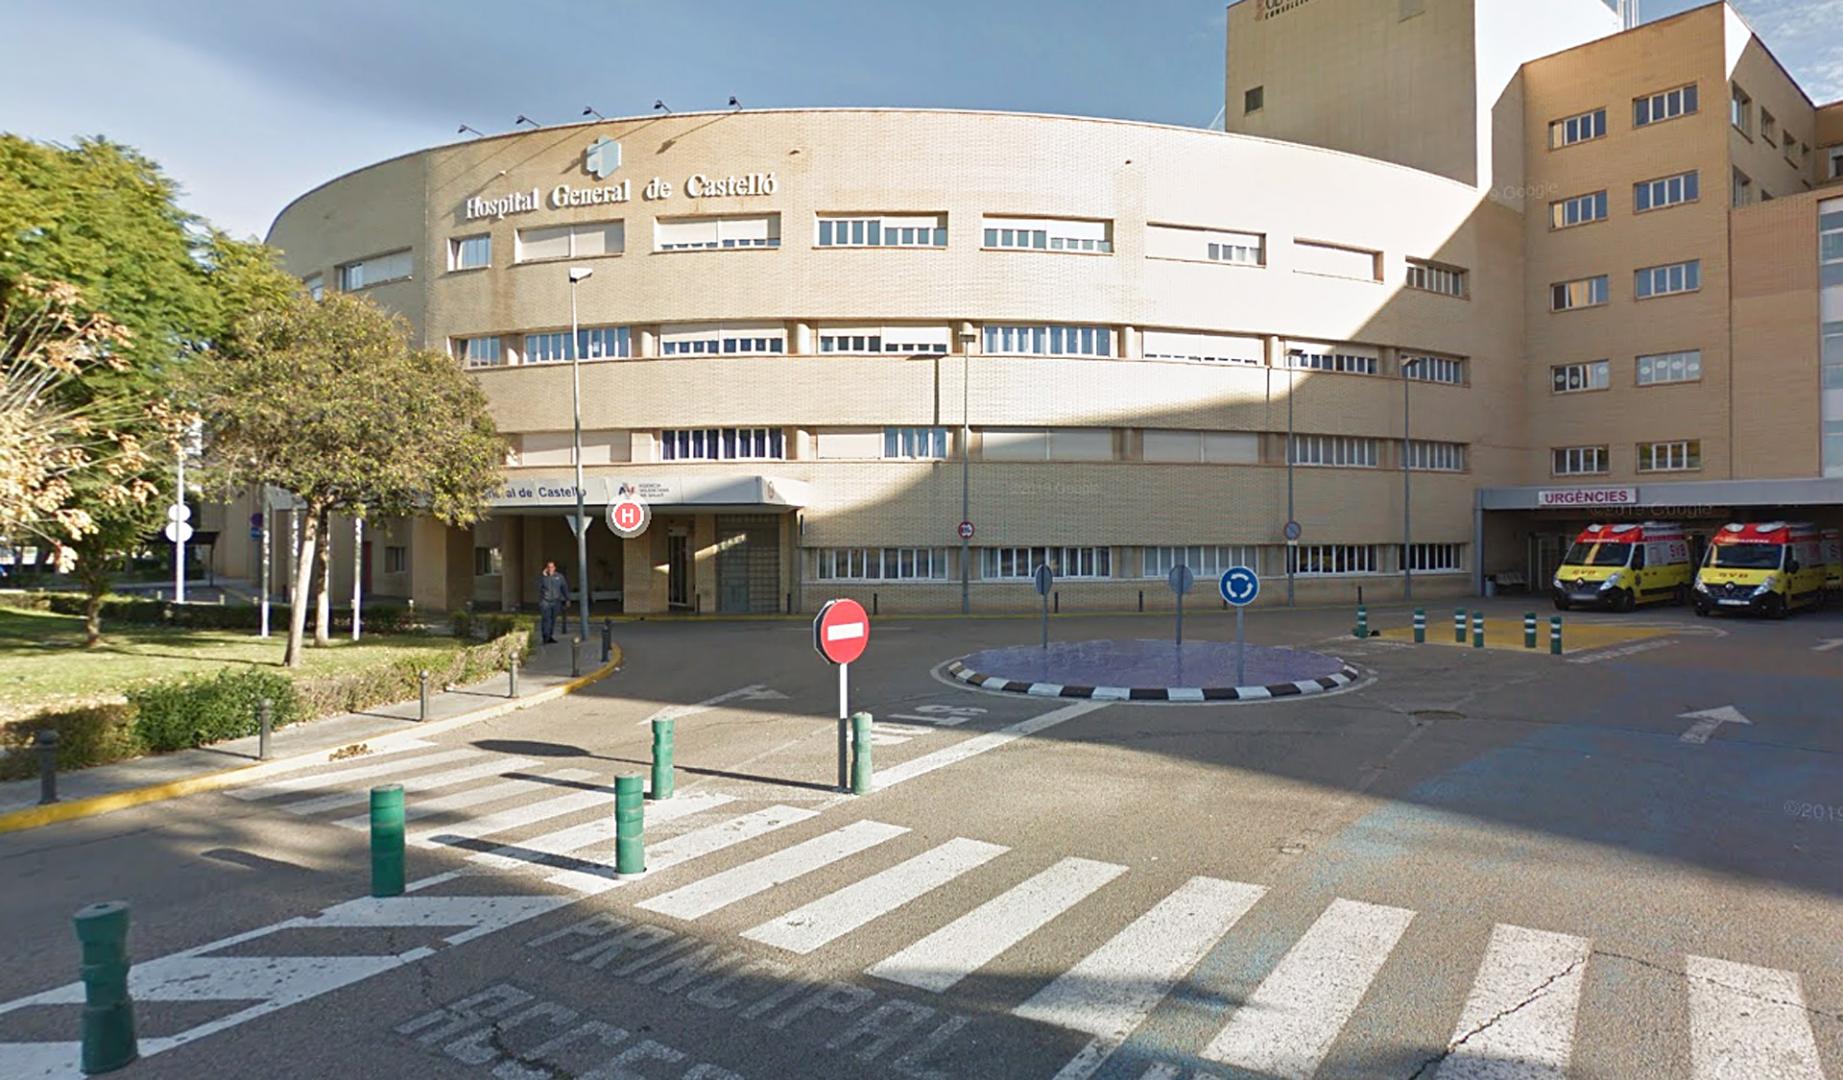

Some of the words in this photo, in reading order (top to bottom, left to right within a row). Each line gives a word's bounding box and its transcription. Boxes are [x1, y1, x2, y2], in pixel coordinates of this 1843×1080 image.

[466, 188, 540, 219] Hospital
[552, 179, 631, 207] General
[646, 177, 673, 199] de
[687, 172, 778, 197] Castelló
[527, 912, 975, 1078] PRINCIPAL
